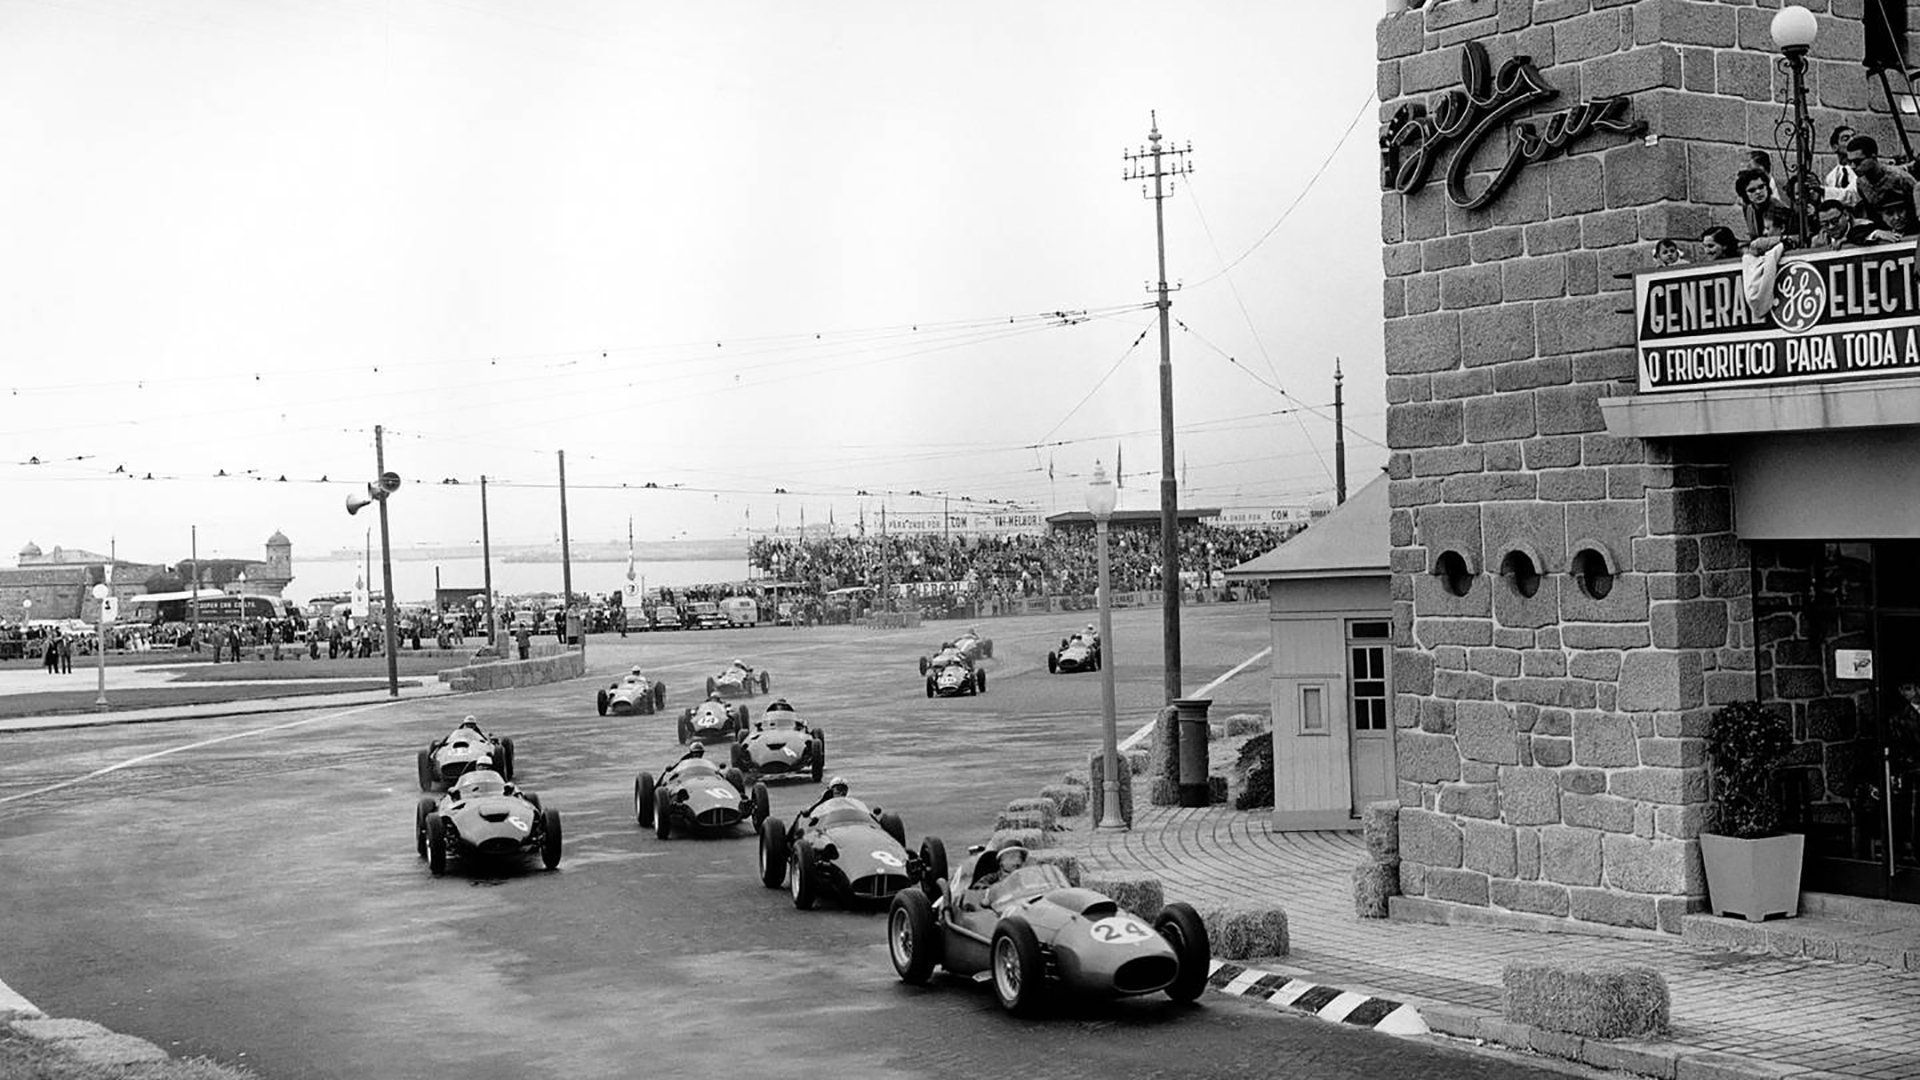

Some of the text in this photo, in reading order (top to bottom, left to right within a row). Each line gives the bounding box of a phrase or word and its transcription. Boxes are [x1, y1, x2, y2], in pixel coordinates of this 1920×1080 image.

[1379, 41, 1560, 195] Bela
[1446, 90, 1649, 210] Cruz
[1829, 256, 1920, 319] ELECT
[1649, 328, 1919, 383] O FRIGORIFICO PARA TODA A
[1271, 510, 1288, 521] COM
[783, 746, 797, 757] 4
[705, 787, 734, 799] 10
[508, 816, 528, 832] 6
[871, 851, 903, 867] 8
[1094, 922, 1149, 941] 24
